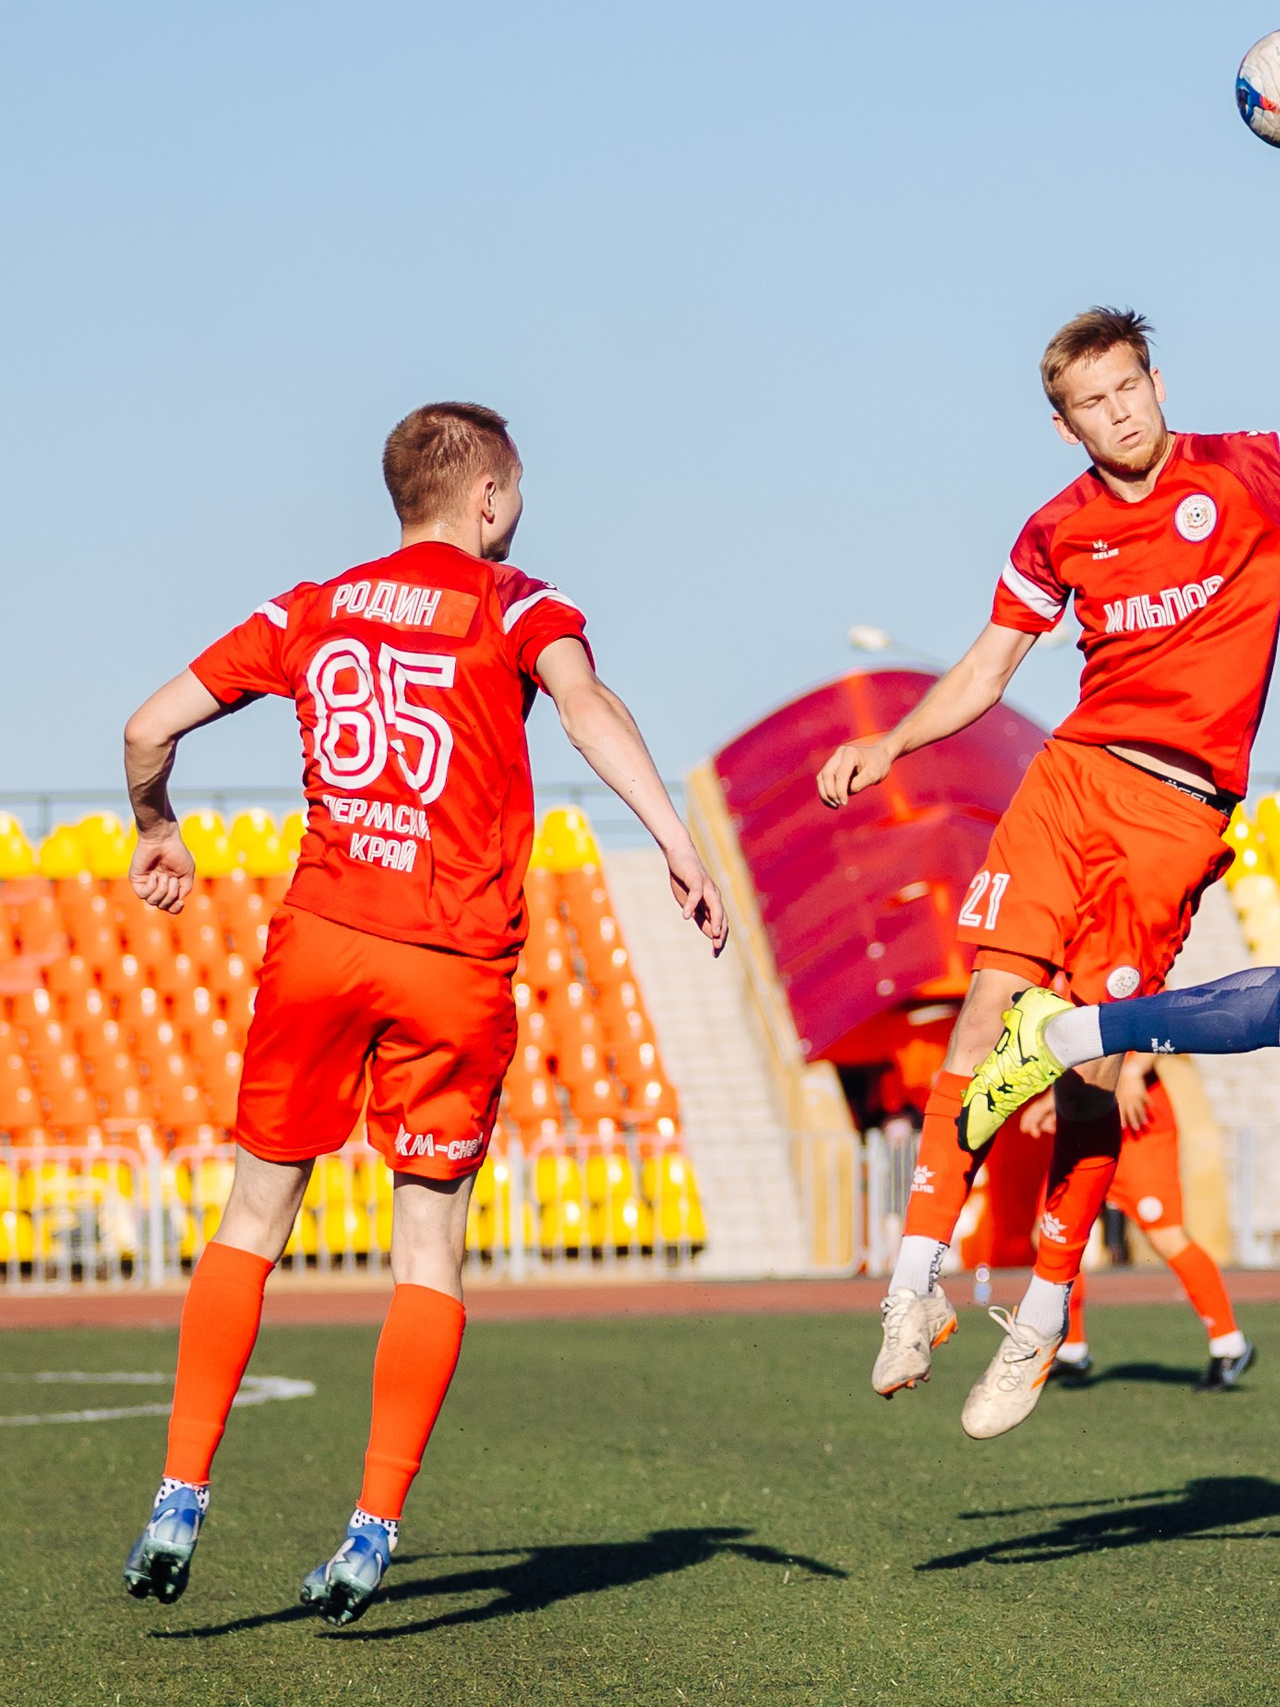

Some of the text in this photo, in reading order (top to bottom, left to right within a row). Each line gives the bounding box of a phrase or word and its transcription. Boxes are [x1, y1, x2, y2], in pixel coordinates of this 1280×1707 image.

[331, 580, 442, 627] РОДИН
[306, 637, 457, 805] 85
[349, 832, 418, 873] КРАЙ
[957, 870, 1011, 931] 21
